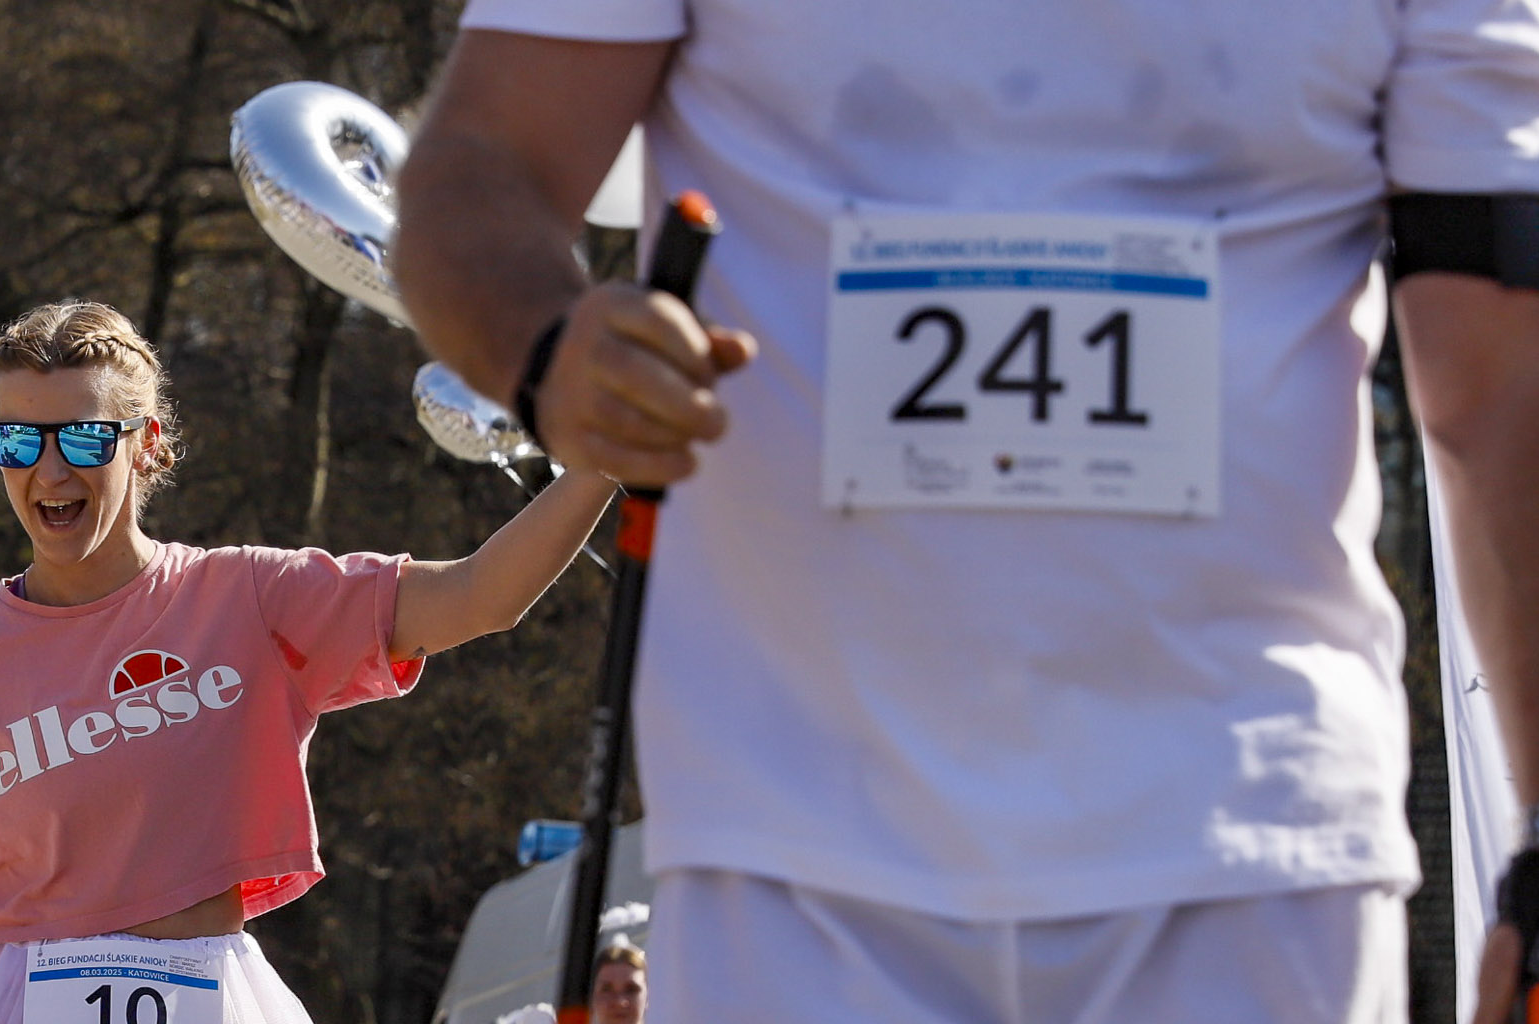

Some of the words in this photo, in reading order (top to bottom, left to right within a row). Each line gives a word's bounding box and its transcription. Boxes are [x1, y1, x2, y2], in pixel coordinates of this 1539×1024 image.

[889, 306, 1151, 428] 241
[48, 956, 66, 966] BIEG
[67, 953, 105, 964] FUNDACJI
[107, 952, 138, 964] ŚLĄSKIE
[139, 955, 168, 967] ANIOŁY
[80, 968, 122, 977] 08.03.2025
[127, 969, 170, 982] KATOWICE
